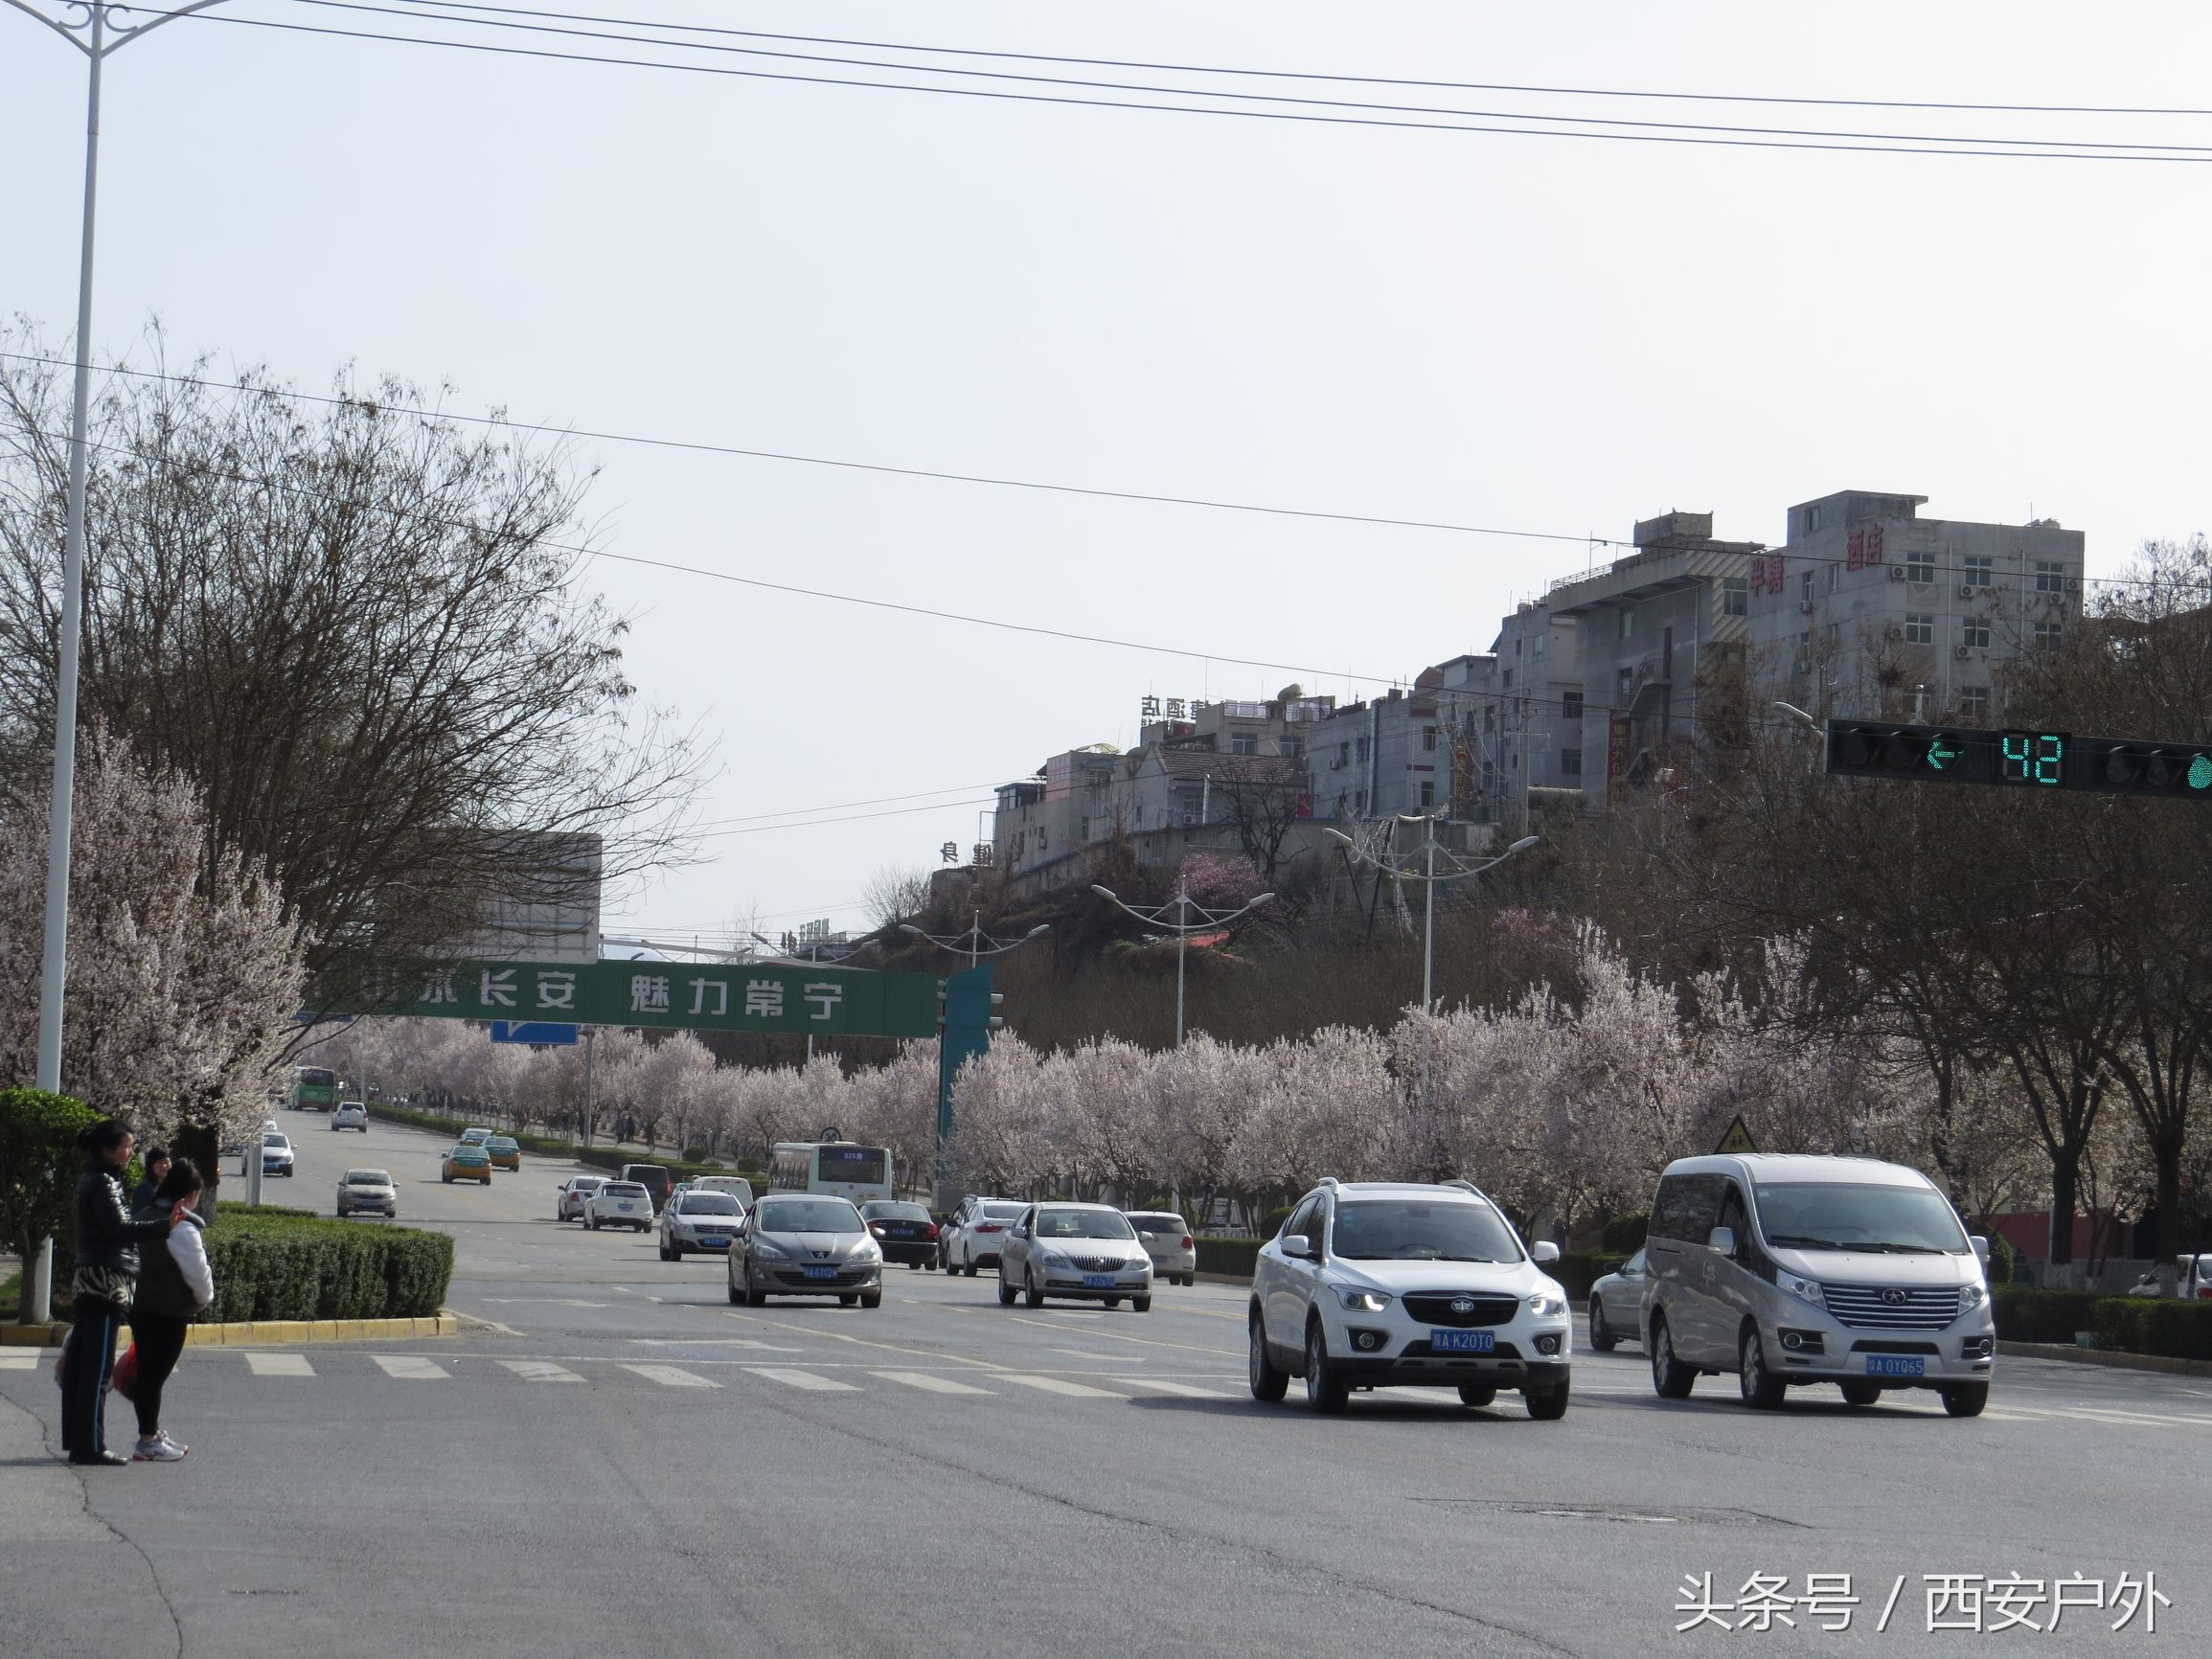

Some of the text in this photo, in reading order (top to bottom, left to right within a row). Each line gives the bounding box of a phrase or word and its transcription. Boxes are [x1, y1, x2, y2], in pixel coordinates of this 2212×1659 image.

[2003, 735, 2062, 783] 42
[630, 975, 842, 1020] 魅力常宁
